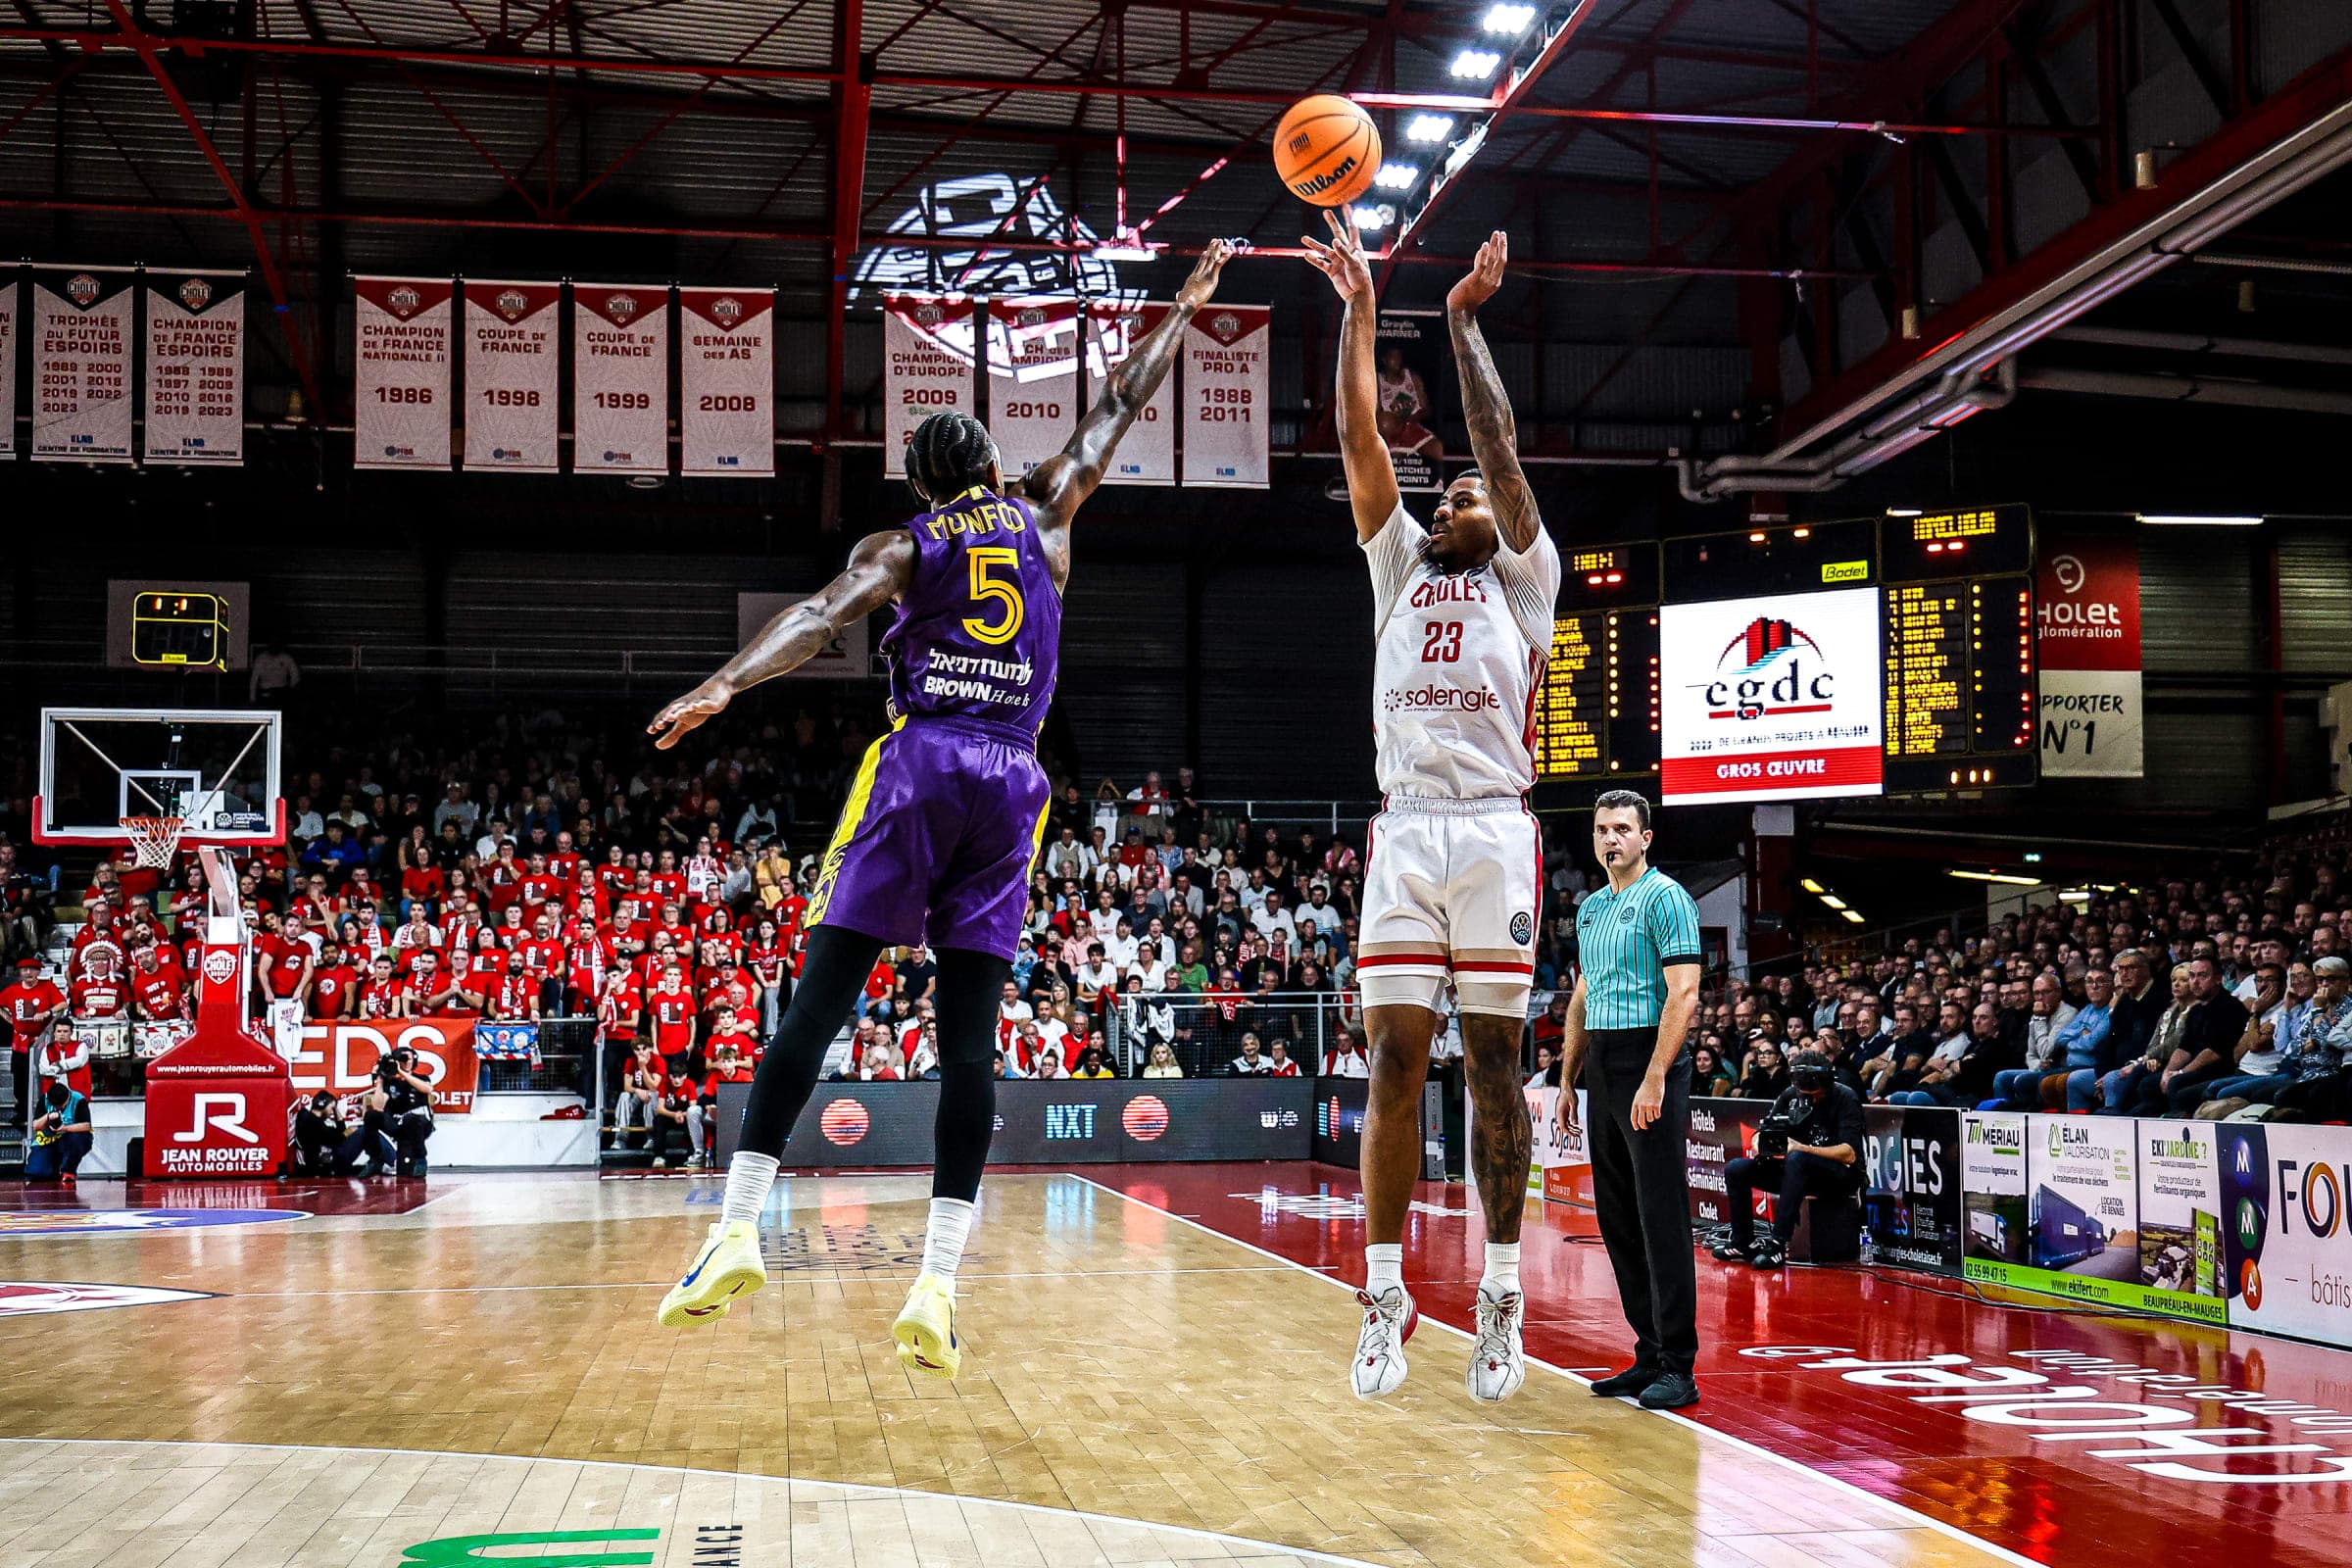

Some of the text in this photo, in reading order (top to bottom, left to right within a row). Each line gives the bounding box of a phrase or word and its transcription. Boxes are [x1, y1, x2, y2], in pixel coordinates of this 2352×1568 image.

[1295, 157, 1356, 196] Wilson
[48, 314, 119, 327] TROPHÉE
[154, 319, 237, 331] CHAMPION
[1381, 319, 1415, 330] Graylin
[69, 329, 120, 341] FUTUR
[363, 325, 444, 337] CHAMPION
[477, 328, 546, 341] COUPE DE
[587, 332, 635, 342] COUPE
[1376, 329, 1421, 338] WARNER
[153, 333, 236, 344] DE FRANCE
[383, 340, 444, 351] FRANCE
[693, 336, 761, 347] SEMAINE
[44, 341, 122, 354] ESPOIRS
[156, 345, 234, 358] ESPOIRS
[481, 342, 542, 354] FRANCE
[591, 346, 651, 357] FRANCE
[729, 349, 752, 360] AS
[363, 352, 431, 362] NATIONALE
[1193, 350, 1258, 362] FINALISTE
[87, 364, 122, 373] 2000
[894, 366, 965, 377] D'EUROPE
[1202, 363, 1250, 373] PRO A
[43, 375, 77, 385] 2001
[86, 390, 122, 400] 2022
[155, 392, 190, 403] 2010
[375, 387, 432, 404] 1986
[484, 390, 540, 407] 1998
[594, 393, 650, 409] 1999
[903, 389, 956, 405] 2009
[1201, 388, 1251, 404] 1988
[43, 403, 77, 413] 2023
[700, 396, 756, 412] 2008
[1006, 403, 1060, 418] 2010
[199, 407, 233, 416] 2023
[1200, 407, 1250, 422] 2011
[1824, 565, 1866, 579] Bodet
[961, 547, 1025, 645] 5
[2038, 625, 2122, 639] glomération
[1421, 620, 1464, 662] 23
[923, 675, 991, 702] BROWN
[1404, 683, 1500, 712] solengie
[2042, 695, 2124, 714] PPORTER
[1776, 731, 1814, 742] PROJETS
[2042, 719, 2095, 755] N°1
[1717, 759, 1826, 779] GROS ŒUVRE
[204, 959, 236, 972] CHOLET
[290, 1025, 447, 1090] EDS
[157, 1064, 275, 1074] www.jeanrouyerautomobiles.fr
[434, 1092, 472, 1105] OLET
[1046, 1104, 1098, 1139] NXT
[1691, 1107, 1715, 1132] Hôtels
[1983, 1123, 2020, 1147] MÉRIAU
[2062, 1122, 2088, 1144] ÉLAN
[162, 1148, 270, 1164] JEAN ROUYER
[1686, 1139, 1725, 1163] Restaurant
[2063, 1146, 2109, 1160] VALORISATION
[168, 1161, 263, 1173] AUTOMOBILES
[1863, 1135, 1942, 1196] RGIES
[2236, 1153, 2250, 1173] M
[1688, 1166, 1727, 1193] Séminaires
[2100, 1196, 2123, 1207] LOCATION
[1699, 1200, 1718, 1221] Cholet
[2101, 1205, 2125, 1216] DE BENNES
[2241, 1215, 2254, 1235] M
[1966, 1262, 2007, 1282] 02 55 99 47 15
[2051, 1278, 2109, 1298] www.ekifert.com
[2143, 1294, 2223, 1320] BEAUPRÉAU-EN-MAUGES
[692, 1525, 743, 1568] ANCE
